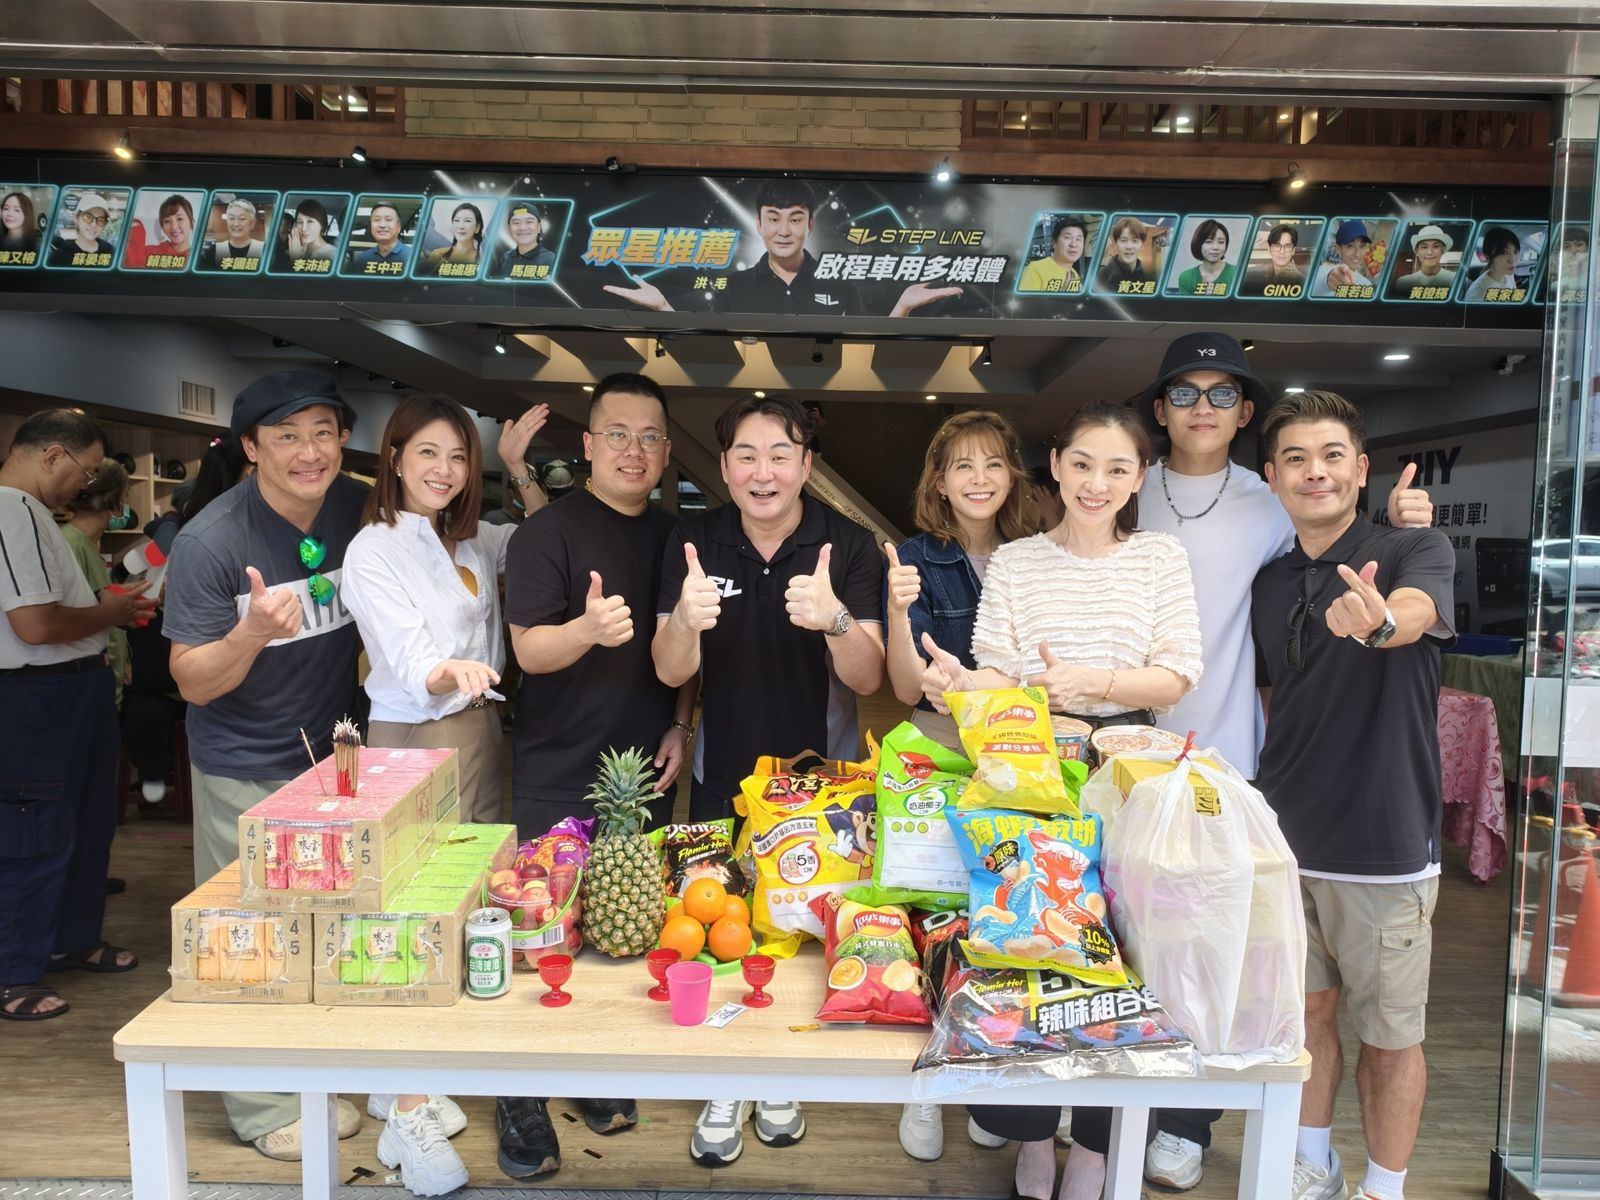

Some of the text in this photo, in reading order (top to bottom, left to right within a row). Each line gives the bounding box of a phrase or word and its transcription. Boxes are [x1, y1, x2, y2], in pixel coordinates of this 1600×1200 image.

[880, 230, 936, 245] STEP
[939, 232, 984, 246] LINE
[364, 261, 403, 274] 王中平
[814, 254, 1007, 283] 啟程車用多媒體
[1117, 280, 1156, 294] 黃文星
[1264, 284, 1302, 297] GINO
[1197, 348, 1217, 357] Y-3
[246, 823, 257, 839] 4
[360, 829, 370, 844] 4
[664, 823, 730, 841] Doritos
[247, 845, 257, 860] 5
[360, 849, 370, 865] 5
[184, 918, 193, 933] 4
[289, 919, 300, 935] 4
[326, 922, 335, 937] 4
[432, 920, 442, 936] 4
[183, 939, 193, 954] 5
[1085, 929, 1110, 949] 10%
[289, 940, 300, 955] 5
[325, 942, 335, 957] 5
